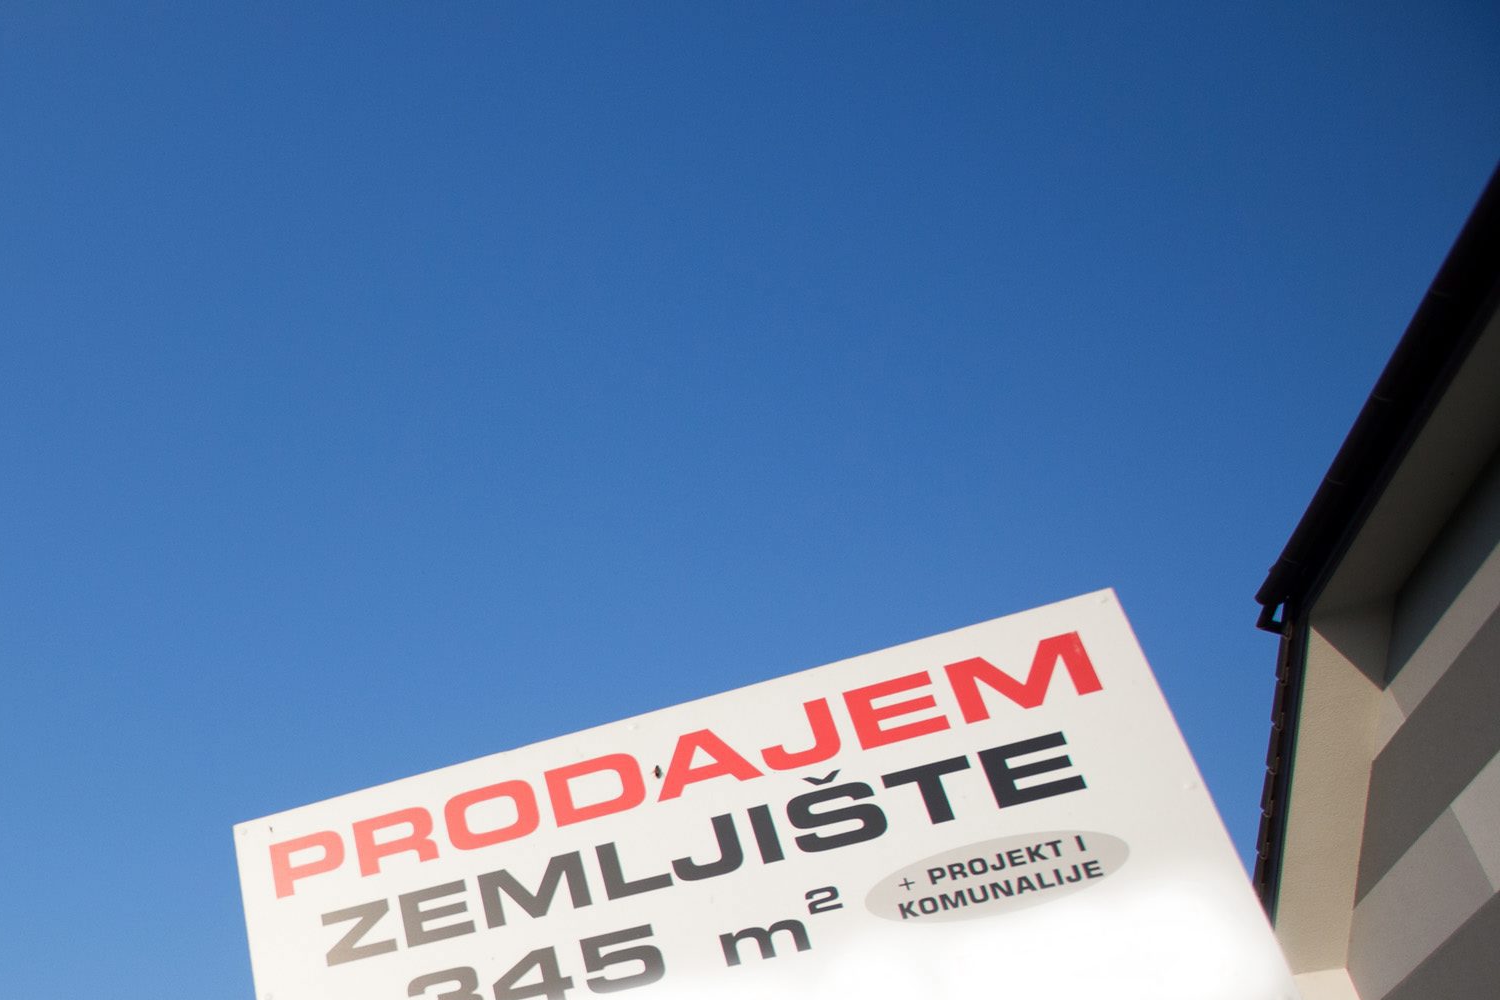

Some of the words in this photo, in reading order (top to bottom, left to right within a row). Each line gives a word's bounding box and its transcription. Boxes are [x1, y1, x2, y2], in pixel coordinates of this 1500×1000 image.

[269, 631, 1103, 898] PRODAJEM
[321, 731, 1088, 966] ZEMLJIŠTE
[897, 860, 1105, 919] KOMUNALIJE
[926, 838, 1063, 885] PROJEKT
[1074, 835, 1087, 852] I
